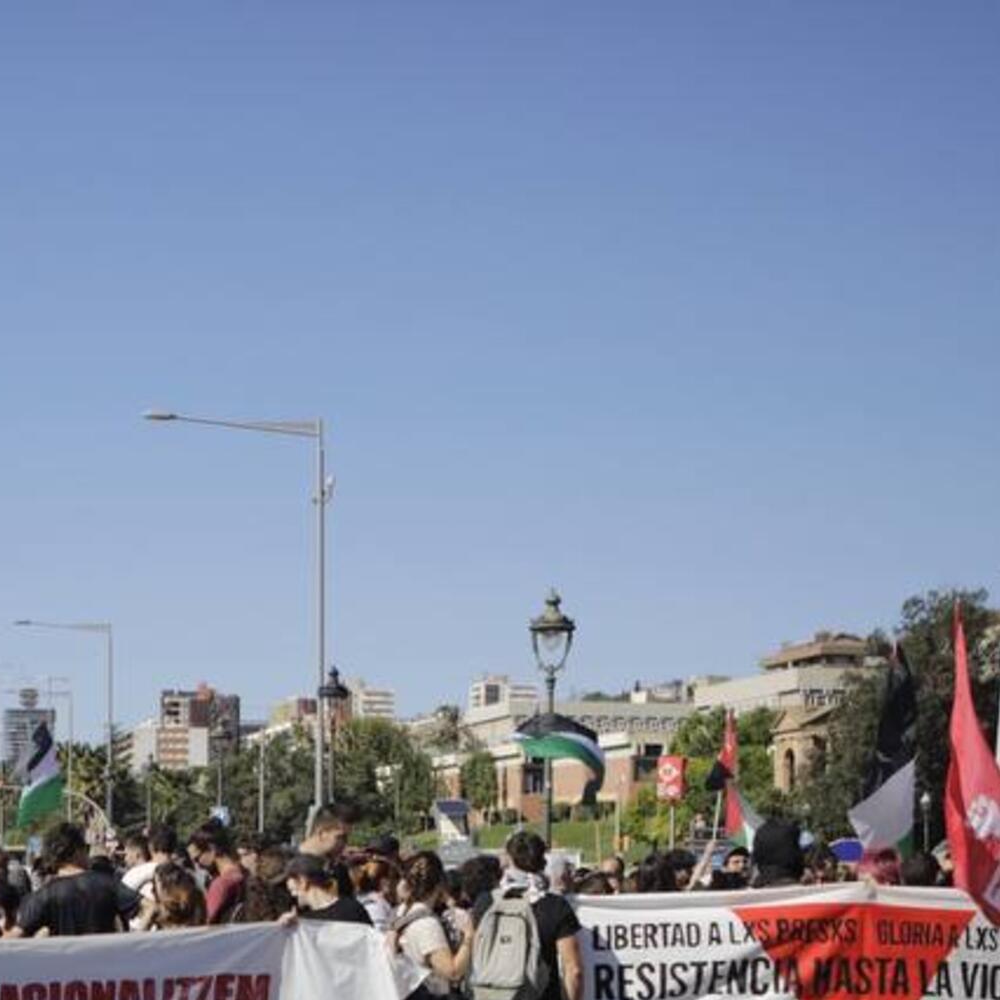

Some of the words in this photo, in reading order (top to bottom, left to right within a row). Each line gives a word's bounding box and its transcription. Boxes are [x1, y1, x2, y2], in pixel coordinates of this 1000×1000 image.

[592, 922, 700, 951] LIBERTAD
[708, 921, 722, 946] A
[876, 919, 944, 946] GLORIA
[965, 926, 1000, 951] LXS
[813, 954, 911, 997] HASTA
[919, 960, 953, 998] LA
